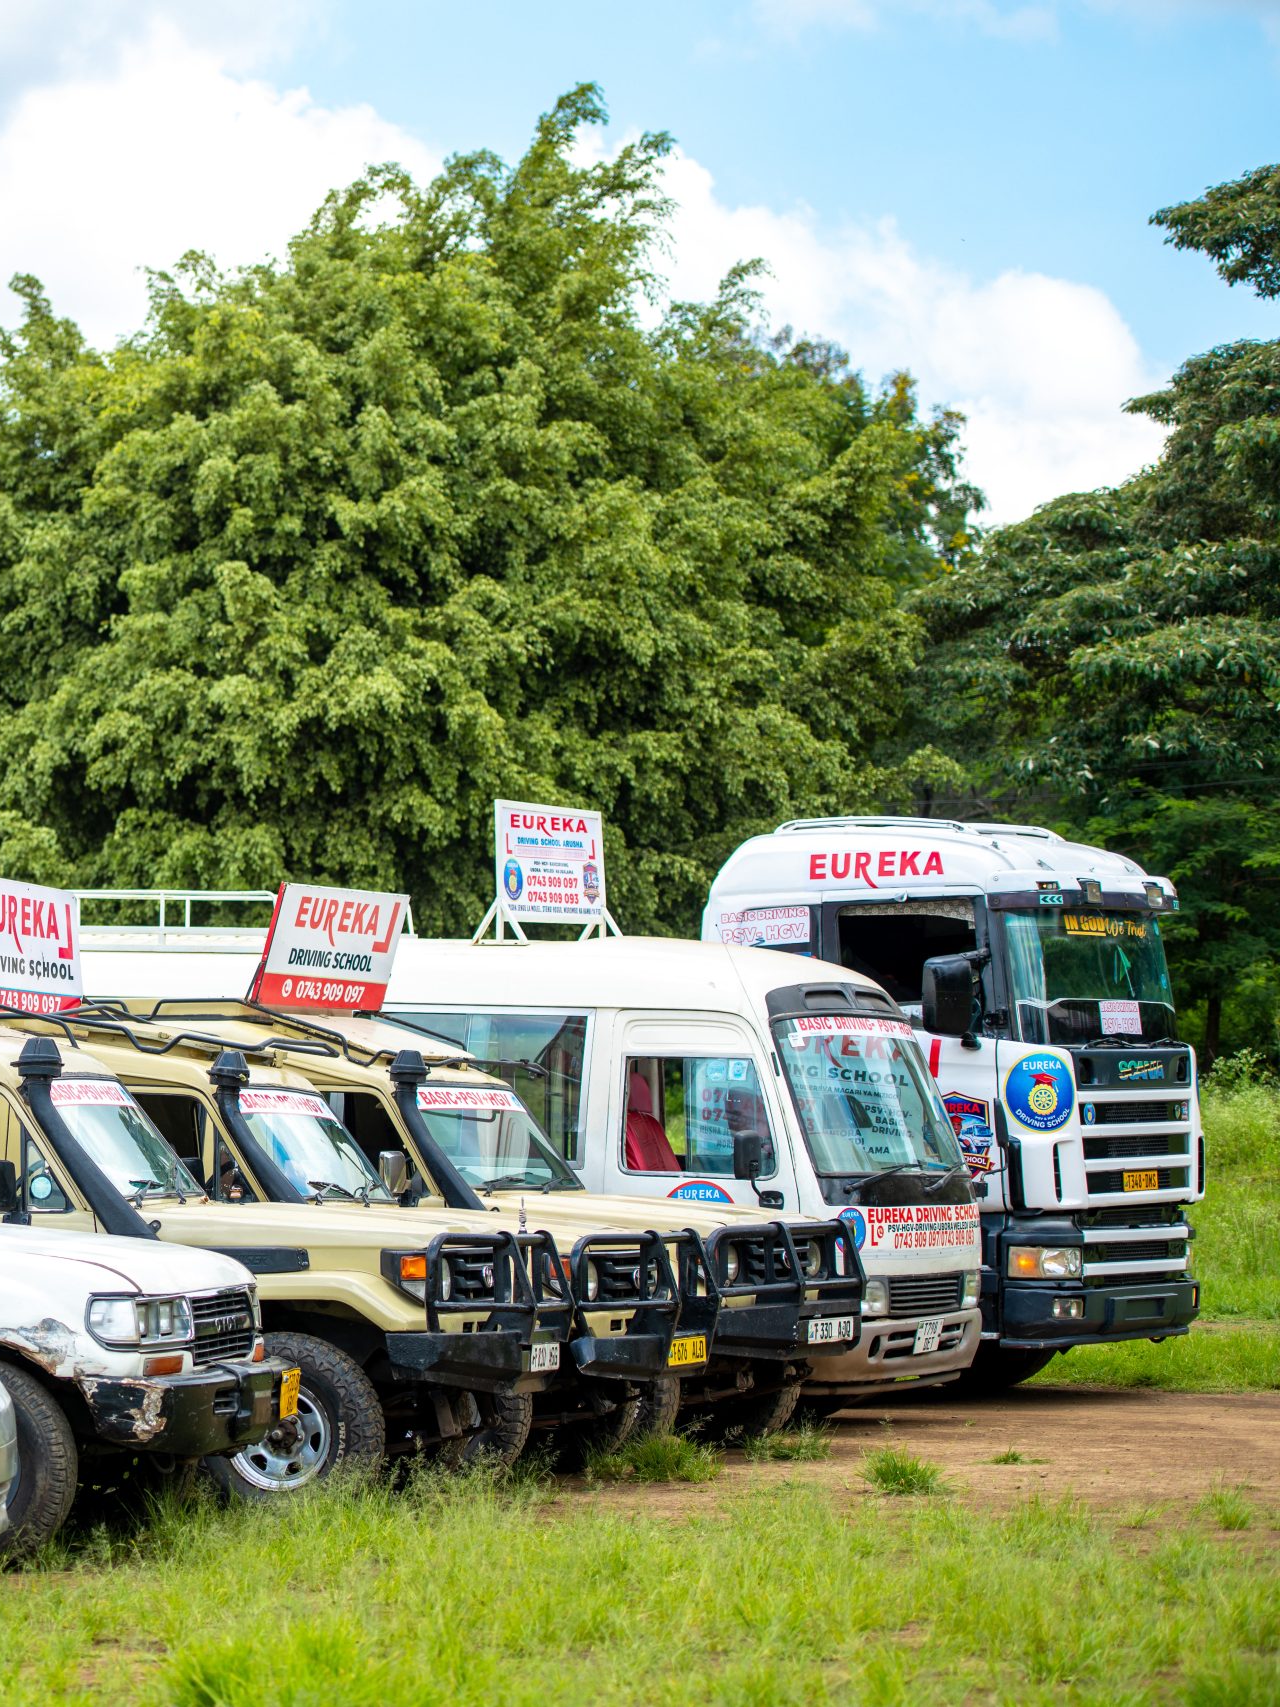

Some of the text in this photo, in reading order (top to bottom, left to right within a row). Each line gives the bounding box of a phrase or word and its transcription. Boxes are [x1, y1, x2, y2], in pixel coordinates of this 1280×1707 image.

[510, 813, 588, 838] EUREKA
[517, 836, 539, 846] DRIVING
[809, 850, 944, 889] EUREKA
[527, 875, 578, 889] 0743 909 097
[528, 891, 548, 903] 0743
[549, 892, 563, 903] 909
[564, 893, 579, 904] 093
[295, 896, 380, 947] EUREKA
[720, 909, 757, 924] BASIC
[1064, 914, 1079, 930] IN
[1080, 915, 1105, 931] GOD
[288, 947, 372, 973] DRIVING SCHOOL
[29, 959, 74, 981] SCHOOL
[296, 980, 365, 1004] 0743 909 097
[21, 992, 40, 1012] 909
[42, 995, 62, 1013] 097
[797, 1017, 832, 1031] BASIC
[1022, 1060, 1062, 1072] EUREKA
[1118, 1060, 1165, 1081] SCANIA
[828, 1067, 909, 1086] SCHOOL
[420, 1091, 510, 1107] BASIC+PSV+HGV
[945, 1102, 981, 1115] REKA
[1015, 1108, 1070, 1128] DRIVING SCHOOL
[964, 1155, 987, 1165] CHOOL
[677, 1189, 720, 1200] EUREKA
[867, 1207, 914, 1224] EUREKA
[916, 1206, 952, 1223] DRIVING
[894, 1233, 912, 1249] 0743
[914, 1232, 926, 1248] 909
[820, 1322, 833, 1339] 330
